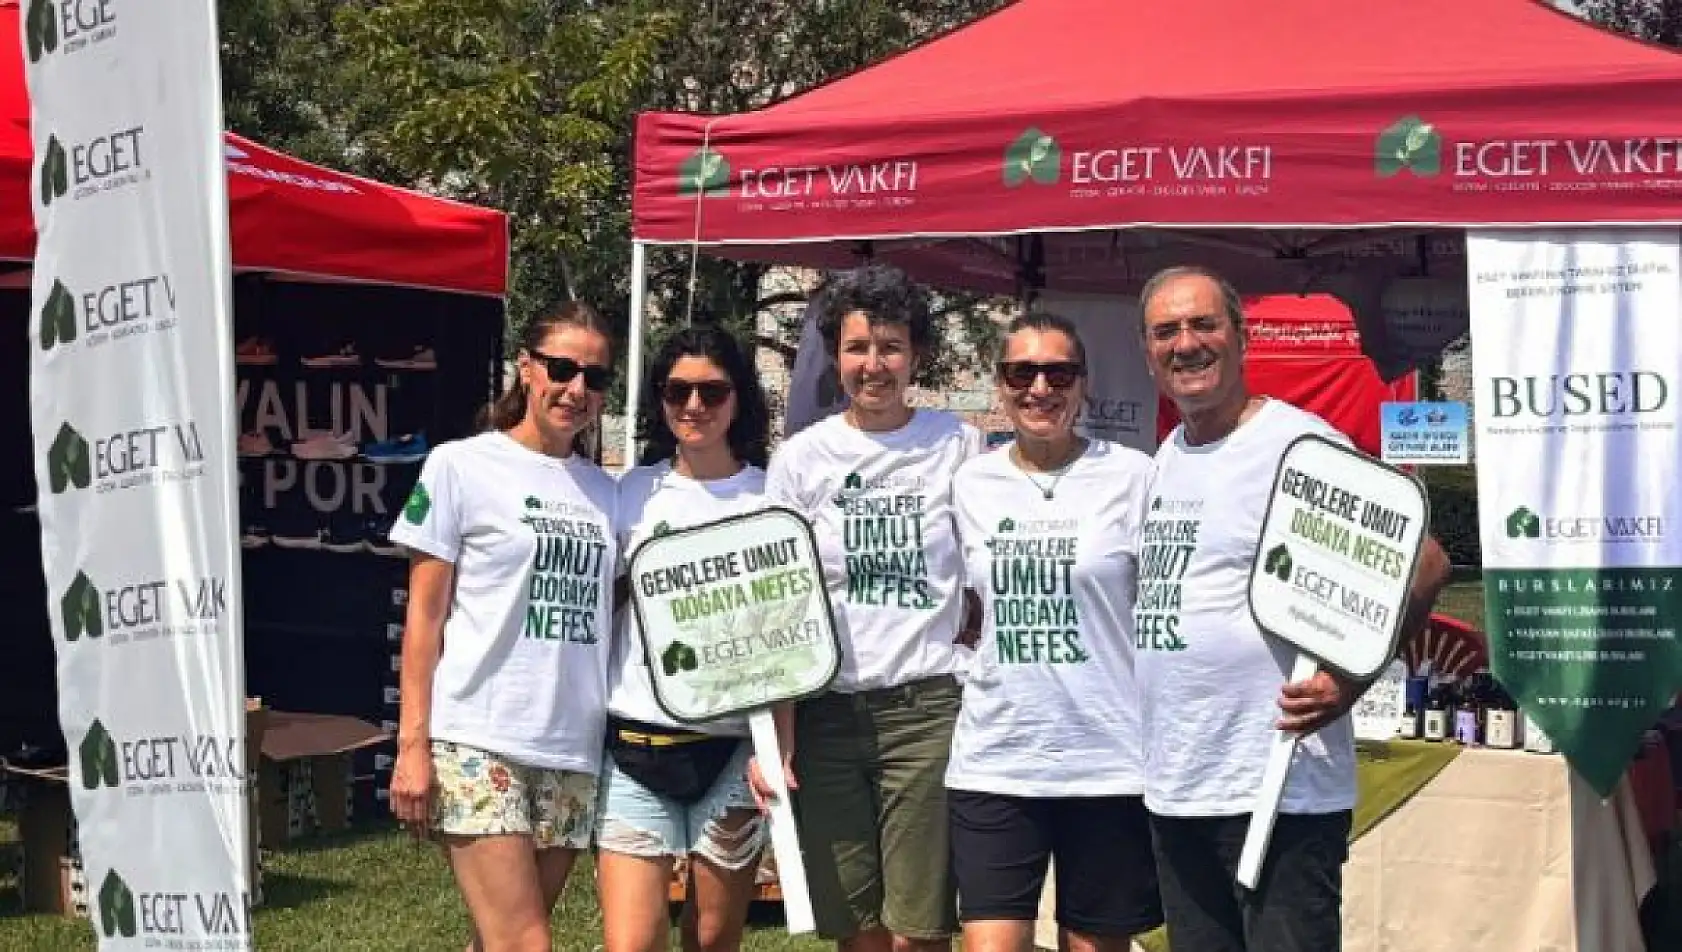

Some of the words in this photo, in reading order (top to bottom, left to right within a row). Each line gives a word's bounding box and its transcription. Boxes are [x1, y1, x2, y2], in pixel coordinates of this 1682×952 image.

[73, 126, 144, 184] EGET
[1072, 147, 1162, 184] EGET
[1168, 144, 1271, 180] VAKFI
[1455, 139, 1558, 177] EGET
[737, 164, 820, 198] EGET
[826, 160, 917, 195] VAKFI
[83, 274, 159, 331] EGET
[1490, 371, 1668, 418] BUSED
[96, 426, 167, 480] EGET
[844, 513, 925, 553] UMUT
[1360, 500, 1410, 543] UMUT
[1545, 517, 1601, 538] EGET
[535, 535, 608, 578] UMUT
[742, 537, 800, 573] UMUT
[1352, 534, 1404, 580] NEFES
[749, 567, 814, 602] NEFES
[847, 573, 930, 609] NEFES
[990, 558, 1077, 595] UMUT
[1295, 564, 1339, 600] EGET
[106, 580, 167, 630] EGET
[525, 604, 595, 644] NEFES
[703, 634, 756, 664] EGET
[995, 628, 1080, 664] NEFES
[122, 736, 178, 781] EGET
[140, 893, 188, 935] EGET
